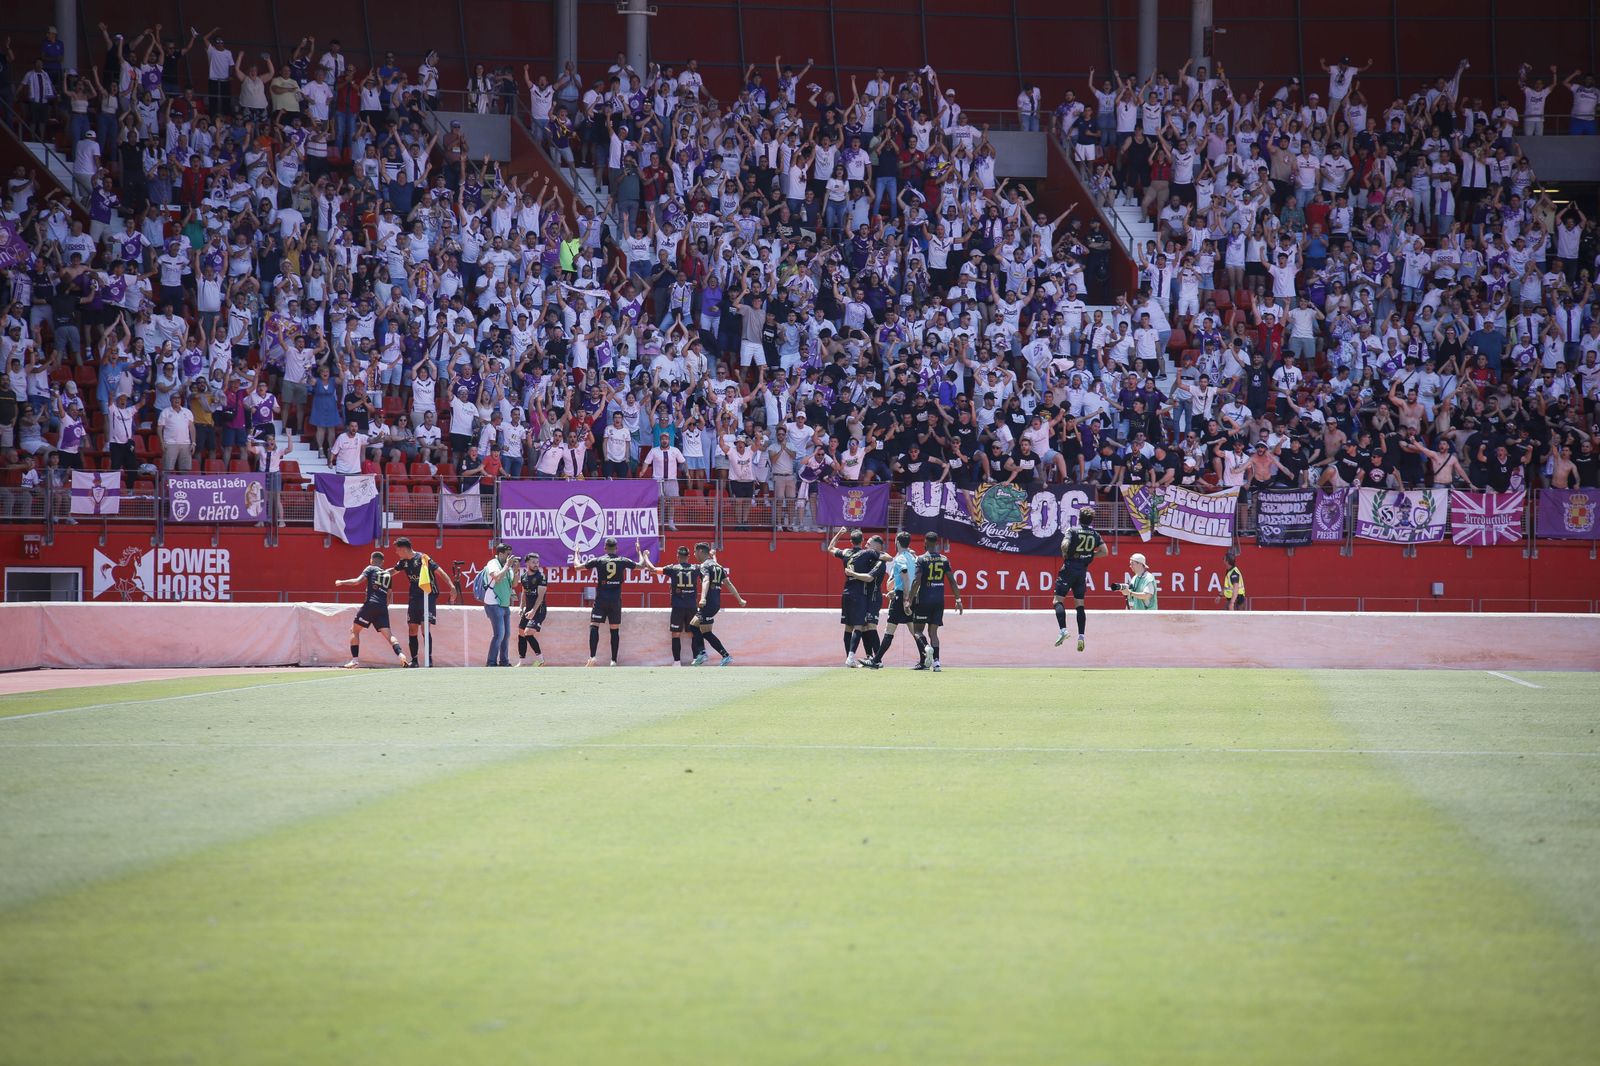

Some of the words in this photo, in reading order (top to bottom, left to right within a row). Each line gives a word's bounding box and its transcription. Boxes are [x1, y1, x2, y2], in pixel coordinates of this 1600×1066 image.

[213, 491, 227, 504] EL
[198, 505, 239, 520] CHATO
[503, 511, 555, 537] CRUZADA
[606, 510, 656, 536] BLANCA
[978, 518, 1019, 539] Hinchas
[1361, 523, 1412, 541] YOUNG
[977, 537, 1000, 549] Real
[1075, 533, 1095, 552] 20
[157, 547, 230, 574] POWER
[606, 561, 617, 579] 9
[676, 570, 694, 588] 11
[927, 562, 944, 580] 15
[157, 574, 230, 600] HORSE
[374, 570, 391, 589] 10
